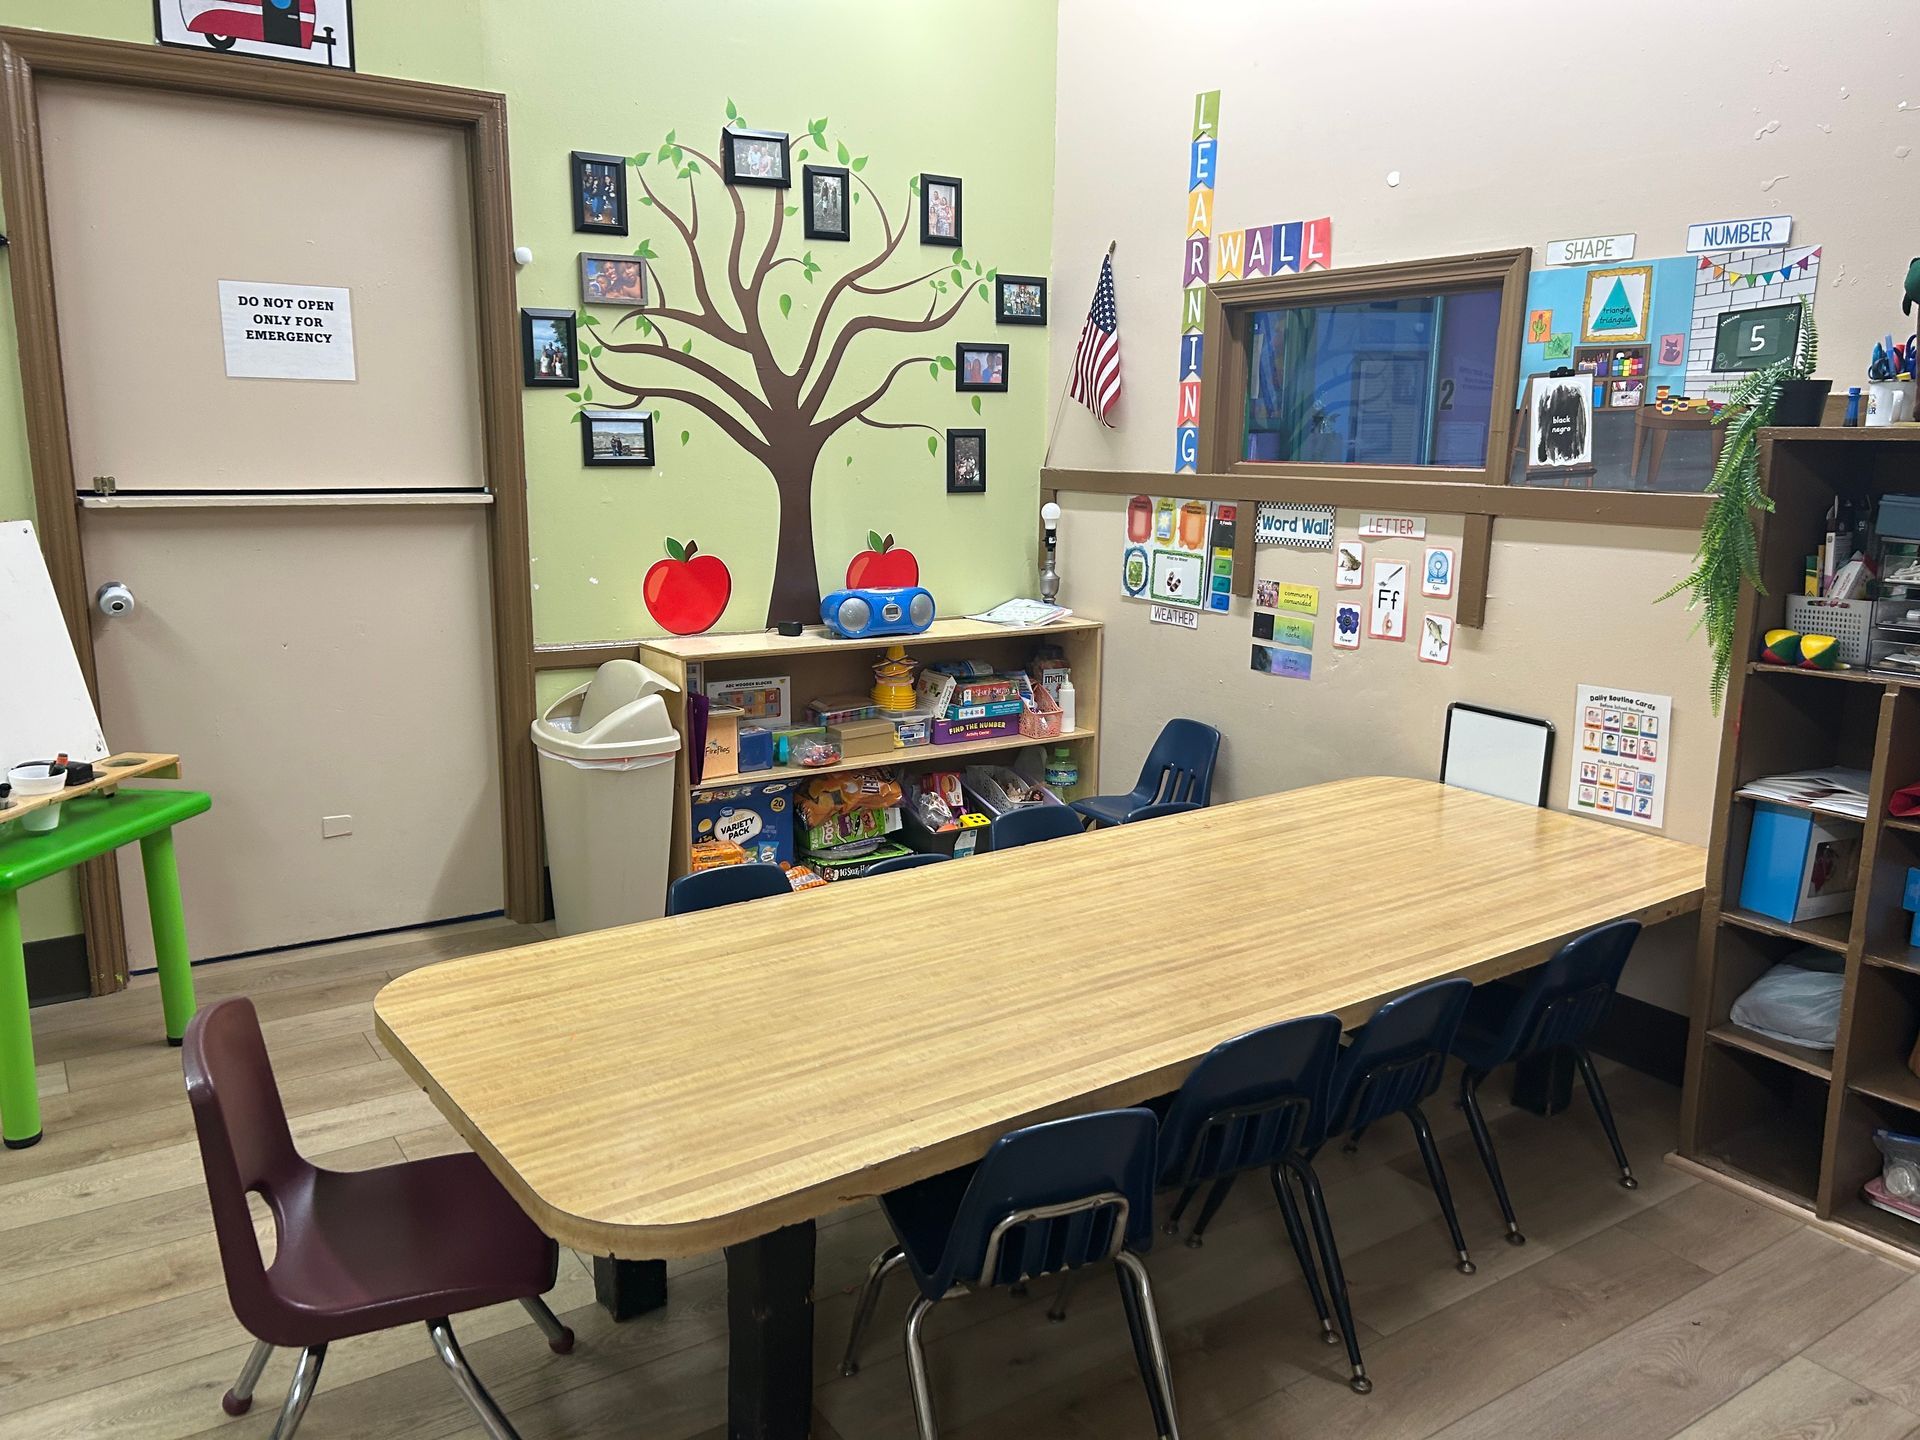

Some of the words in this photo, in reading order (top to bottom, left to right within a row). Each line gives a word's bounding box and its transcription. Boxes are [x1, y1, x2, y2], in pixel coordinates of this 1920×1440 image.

[1704, 221, 1772, 246] NUMBER
[1220, 223, 1323, 270] WALL
[1564, 238, 1613, 260] SHAPE
[1181, 94, 1214, 463] LEARNING
[238, 296, 259, 306] DO
[263, 297, 293, 308] NOT
[297, 299, 334, 311] OPEN
[1603, 305, 1630, 315] triangle
[253, 314, 291, 325] ONLY
[295, 316, 324, 327] FOR
[245, 330, 332, 343] EMERGENCY
[1750, 325, 1765, 351] 5
[1440, 379, 1455, 411] 2
[1552, 415, 1570, 424] black
[1551, 426, 1571, 434] negro
[1262, 514, 1298, 533] Word
[1302, 517, 1330, 536] Wall
[1368, 518, 1414, 534] LETTER
[1284, 591, 1313, 600] community
[1378, 589, 1400, 610] Ff
[1153, 606, 1194, 625] WEATHER
[1589, 694, 1607, 702] Daily
[1609, 694, 1633, 704] Routine
[1635, 699, 1656, 711] Cards
[949, 725, 965, 735] FIND
[979, 721, 1006, 729] NUMBER
[773, 799, 784, 807] 20
[720, 816, 755, 835] VARIETY
[728, 826, 750, 840] PACK
